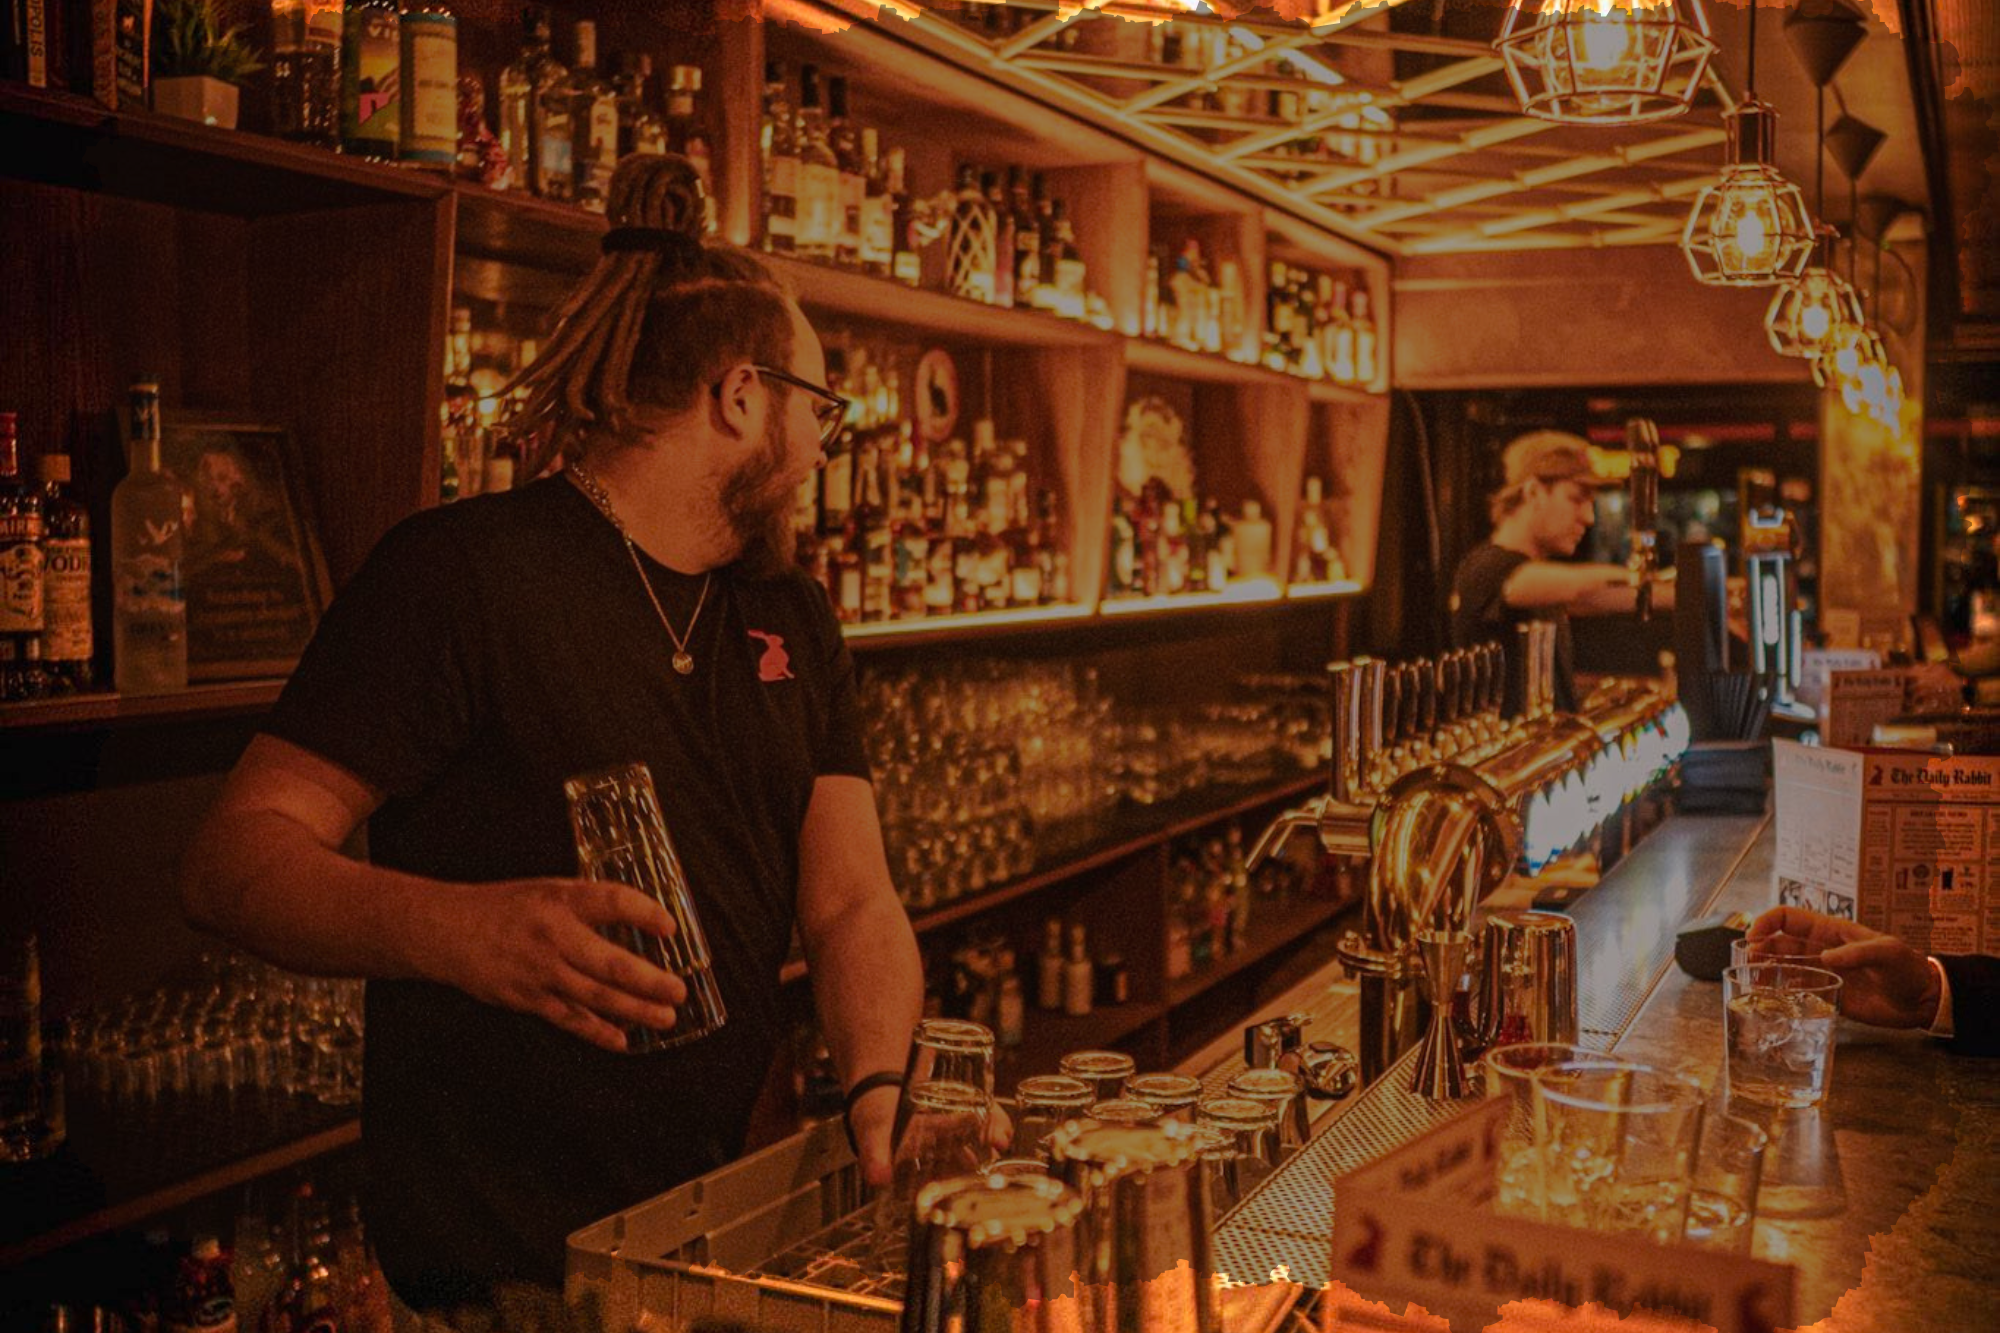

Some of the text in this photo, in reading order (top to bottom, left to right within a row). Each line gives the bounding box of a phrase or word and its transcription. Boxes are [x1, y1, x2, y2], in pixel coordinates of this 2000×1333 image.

[1891, 768, 1991, 787] The Daily Rabbit
